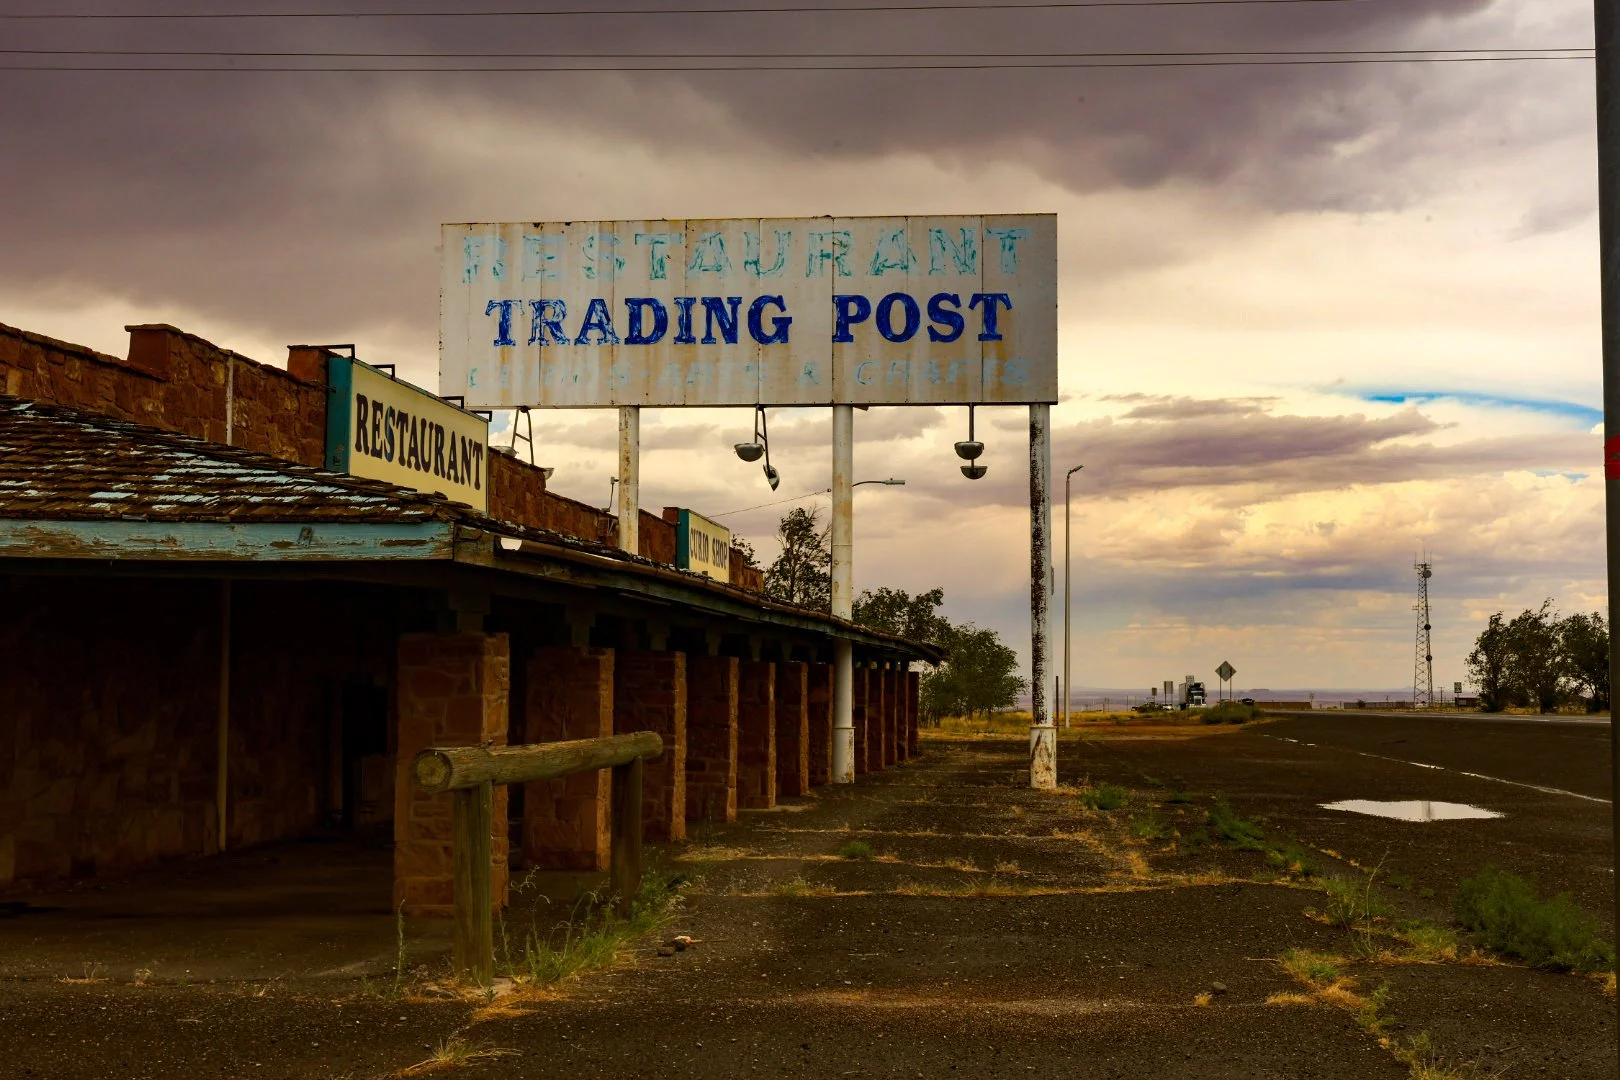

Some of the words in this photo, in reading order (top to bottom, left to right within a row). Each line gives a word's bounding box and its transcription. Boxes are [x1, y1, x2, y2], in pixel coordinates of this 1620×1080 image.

[463, 227, 1030, 283] RESTAURANT
[485, 294, 792, 347] TRADING
[832, 292, 1012, 343] POST
[355, 393, 484, 490] RESTAURANT
[712, 537, 728, 570] SHOP
